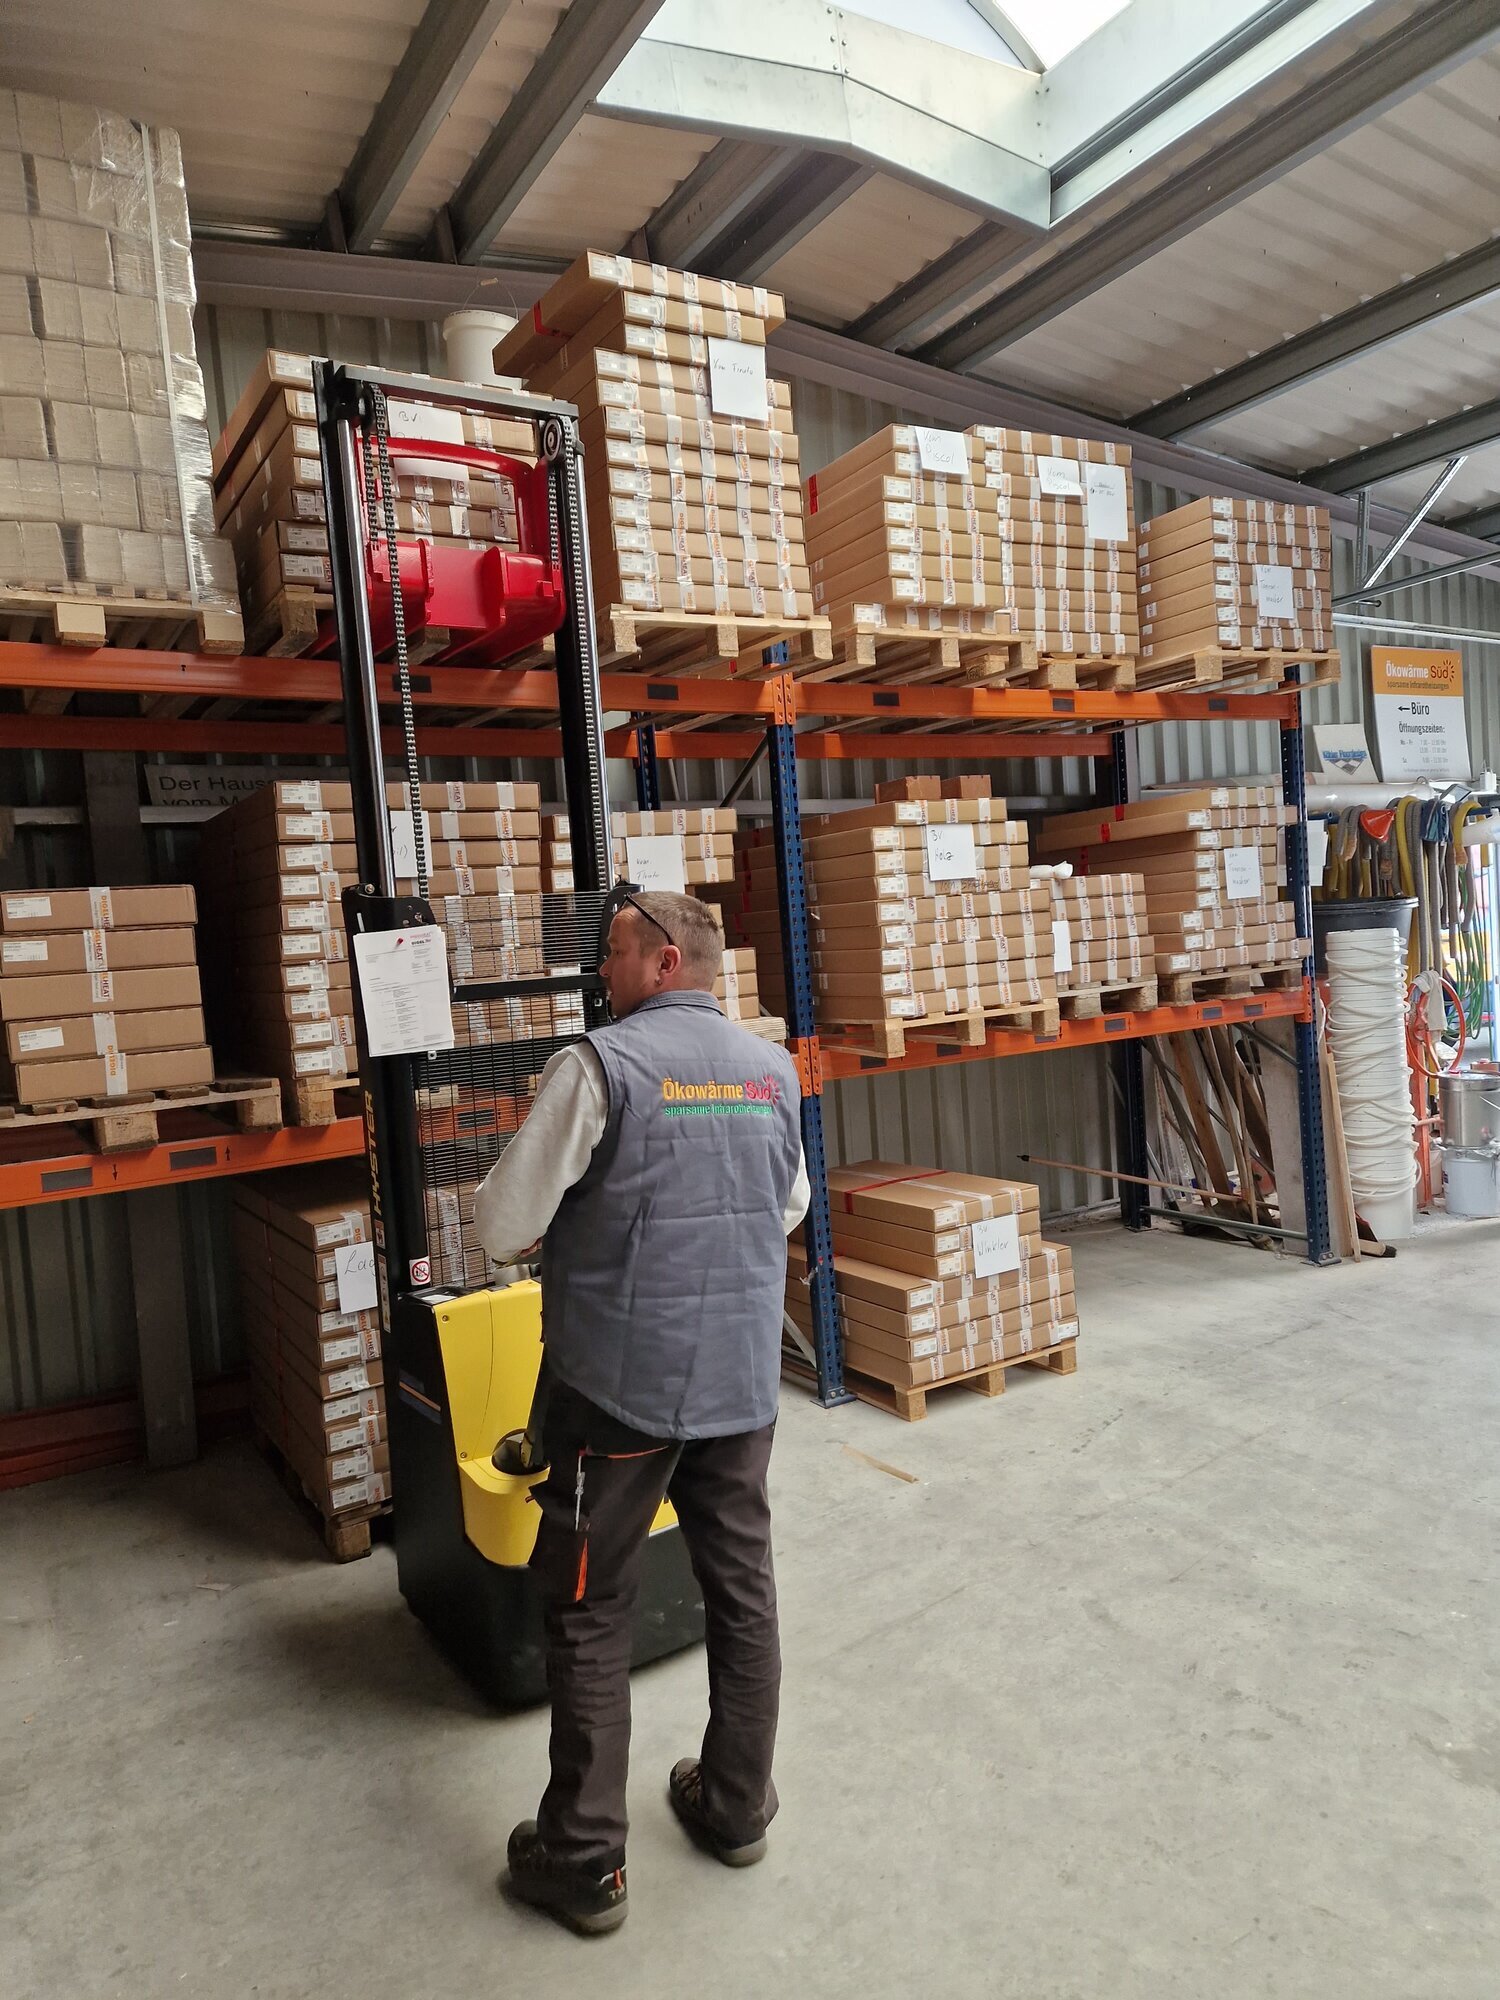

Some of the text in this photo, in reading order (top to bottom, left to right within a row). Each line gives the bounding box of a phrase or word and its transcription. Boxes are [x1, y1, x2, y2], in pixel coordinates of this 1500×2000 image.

[1385, 660, 1449, 679] Ökowärme Süd
[1411, 702, 1430, 716] Büro
[1398, 720, 1446, 736] Öffnungszeiten:
[159, 776, 204, 791] Der
[663, 1077, 771, 1101] Ökowärme Süd
[665, 1104, 711, 1117] sparsame
[364, 1090, 382, 1216] HYSTER
